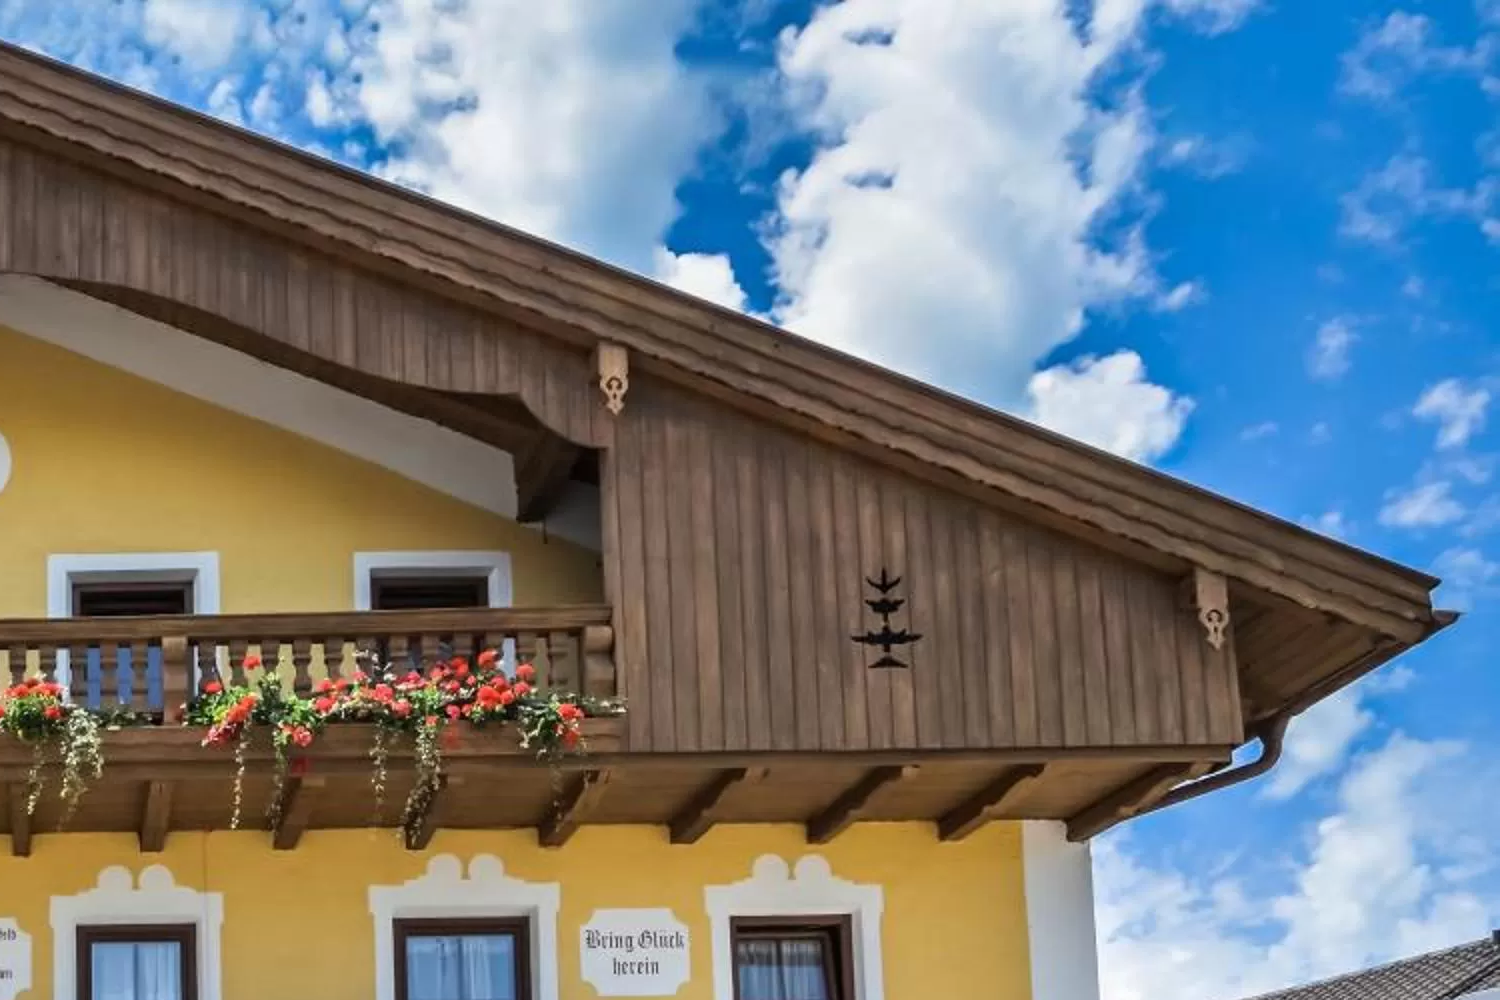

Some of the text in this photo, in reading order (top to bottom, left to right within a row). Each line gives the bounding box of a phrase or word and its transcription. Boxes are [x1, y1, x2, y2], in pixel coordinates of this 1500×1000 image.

[585, 929, 685, 953] Bring Glück
[612, 956, 660, 975] herein
